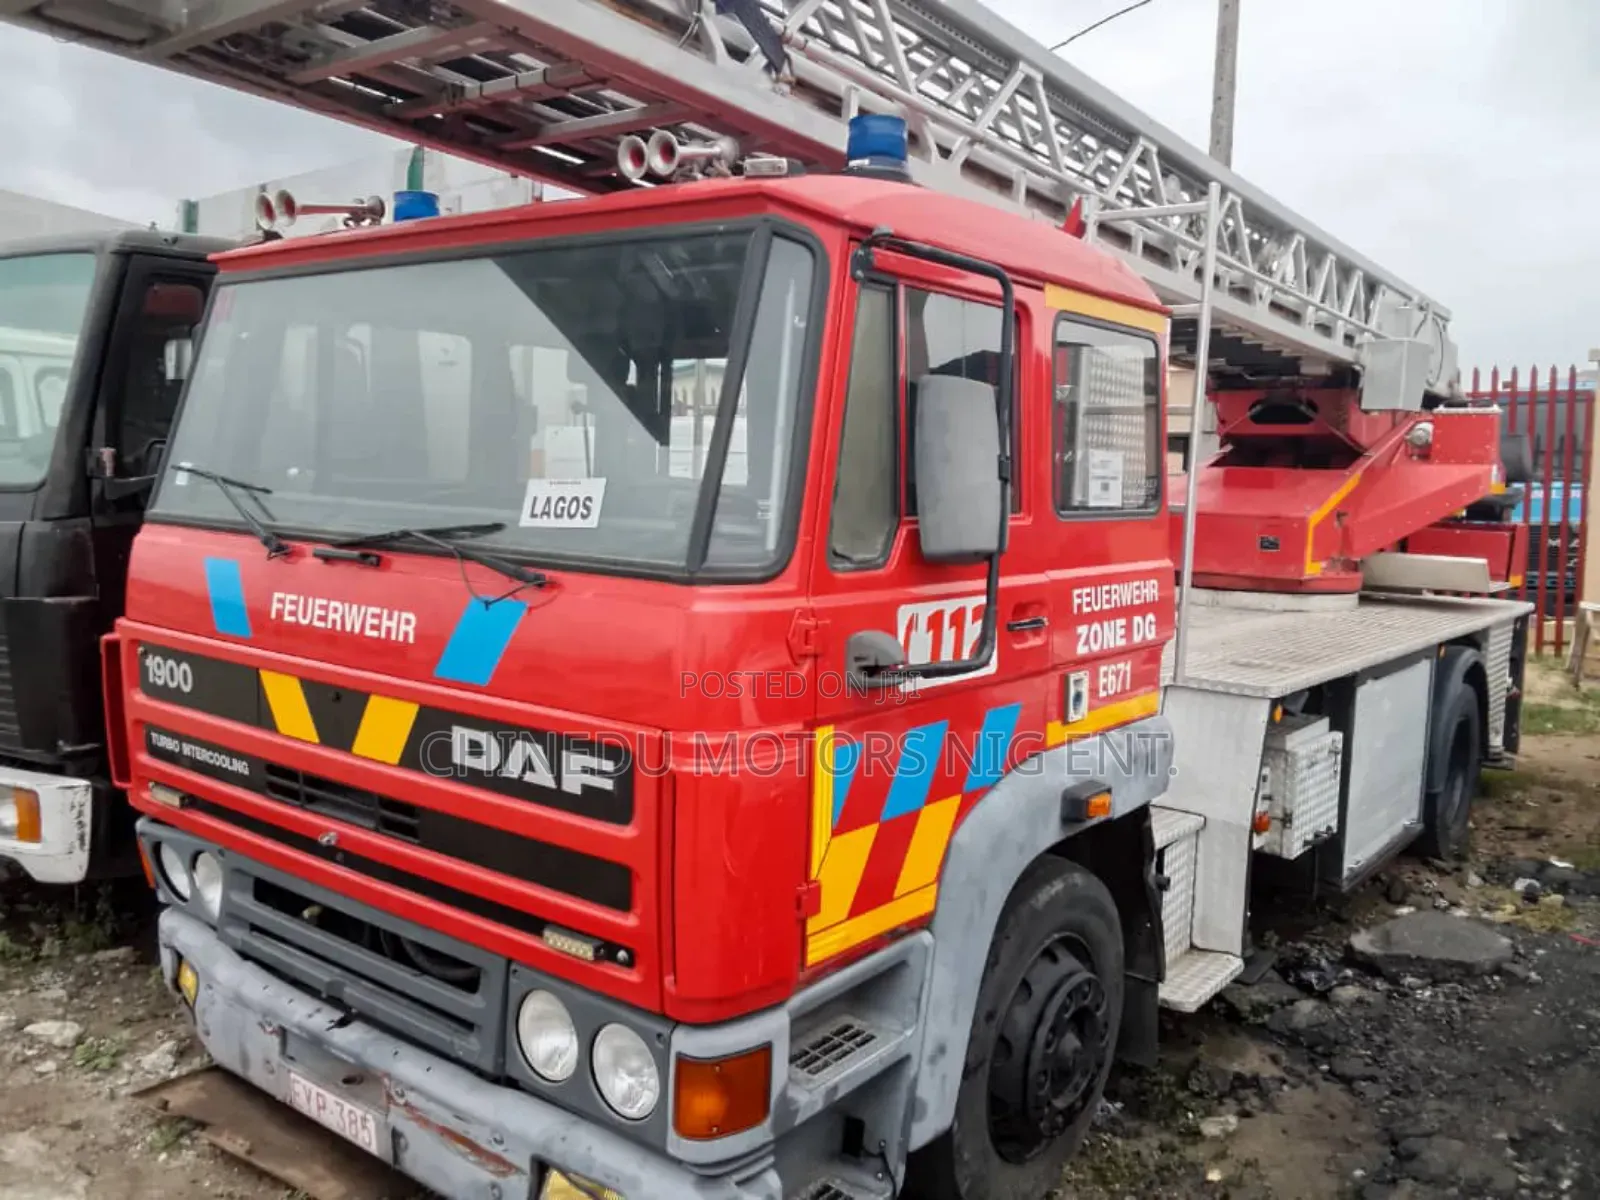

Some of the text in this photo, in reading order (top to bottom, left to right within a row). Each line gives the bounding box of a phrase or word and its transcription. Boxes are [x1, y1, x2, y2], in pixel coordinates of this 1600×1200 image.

[529, 496, 593, 520] LAGOS
[270, 591, 416, 643] FEUERWEHR
[1072, 579, 1159, 615] FEUERWEHR
[1076, 612, 1157, 655] ZONE DG
[145, 654, 194, 693] 1900
[1099, 660, 1132, 697] E671
[150, 731, 250, 776] TURBO INTERCOOLING
[451, 724, 616, 796] DAF
